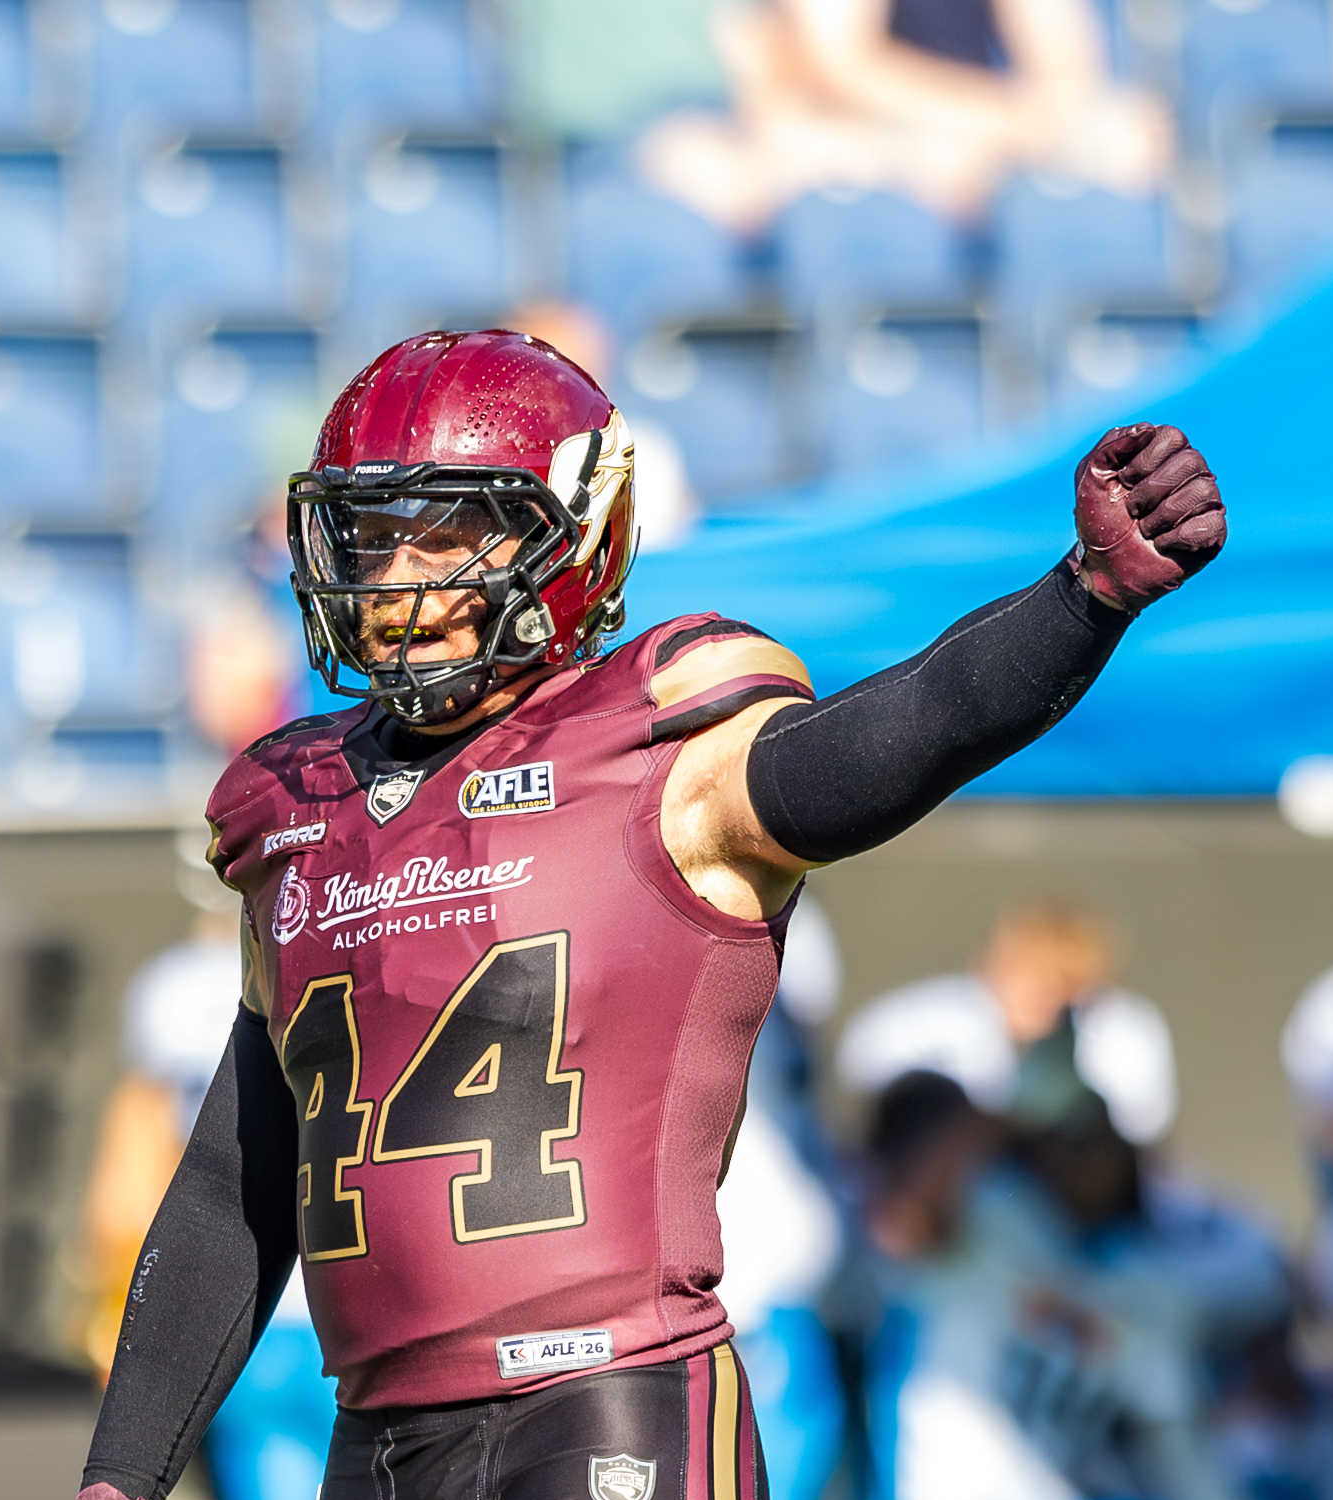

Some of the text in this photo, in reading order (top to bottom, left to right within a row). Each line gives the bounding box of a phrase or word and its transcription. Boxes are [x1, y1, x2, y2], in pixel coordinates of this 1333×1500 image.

[472, 766, 549, 807] AFLE
[332, 903, 497, 950] ALKOHOLFREI
[282, 930, 585, 1262] 44
[541, 1342, 604, 1358] AFLE '26
